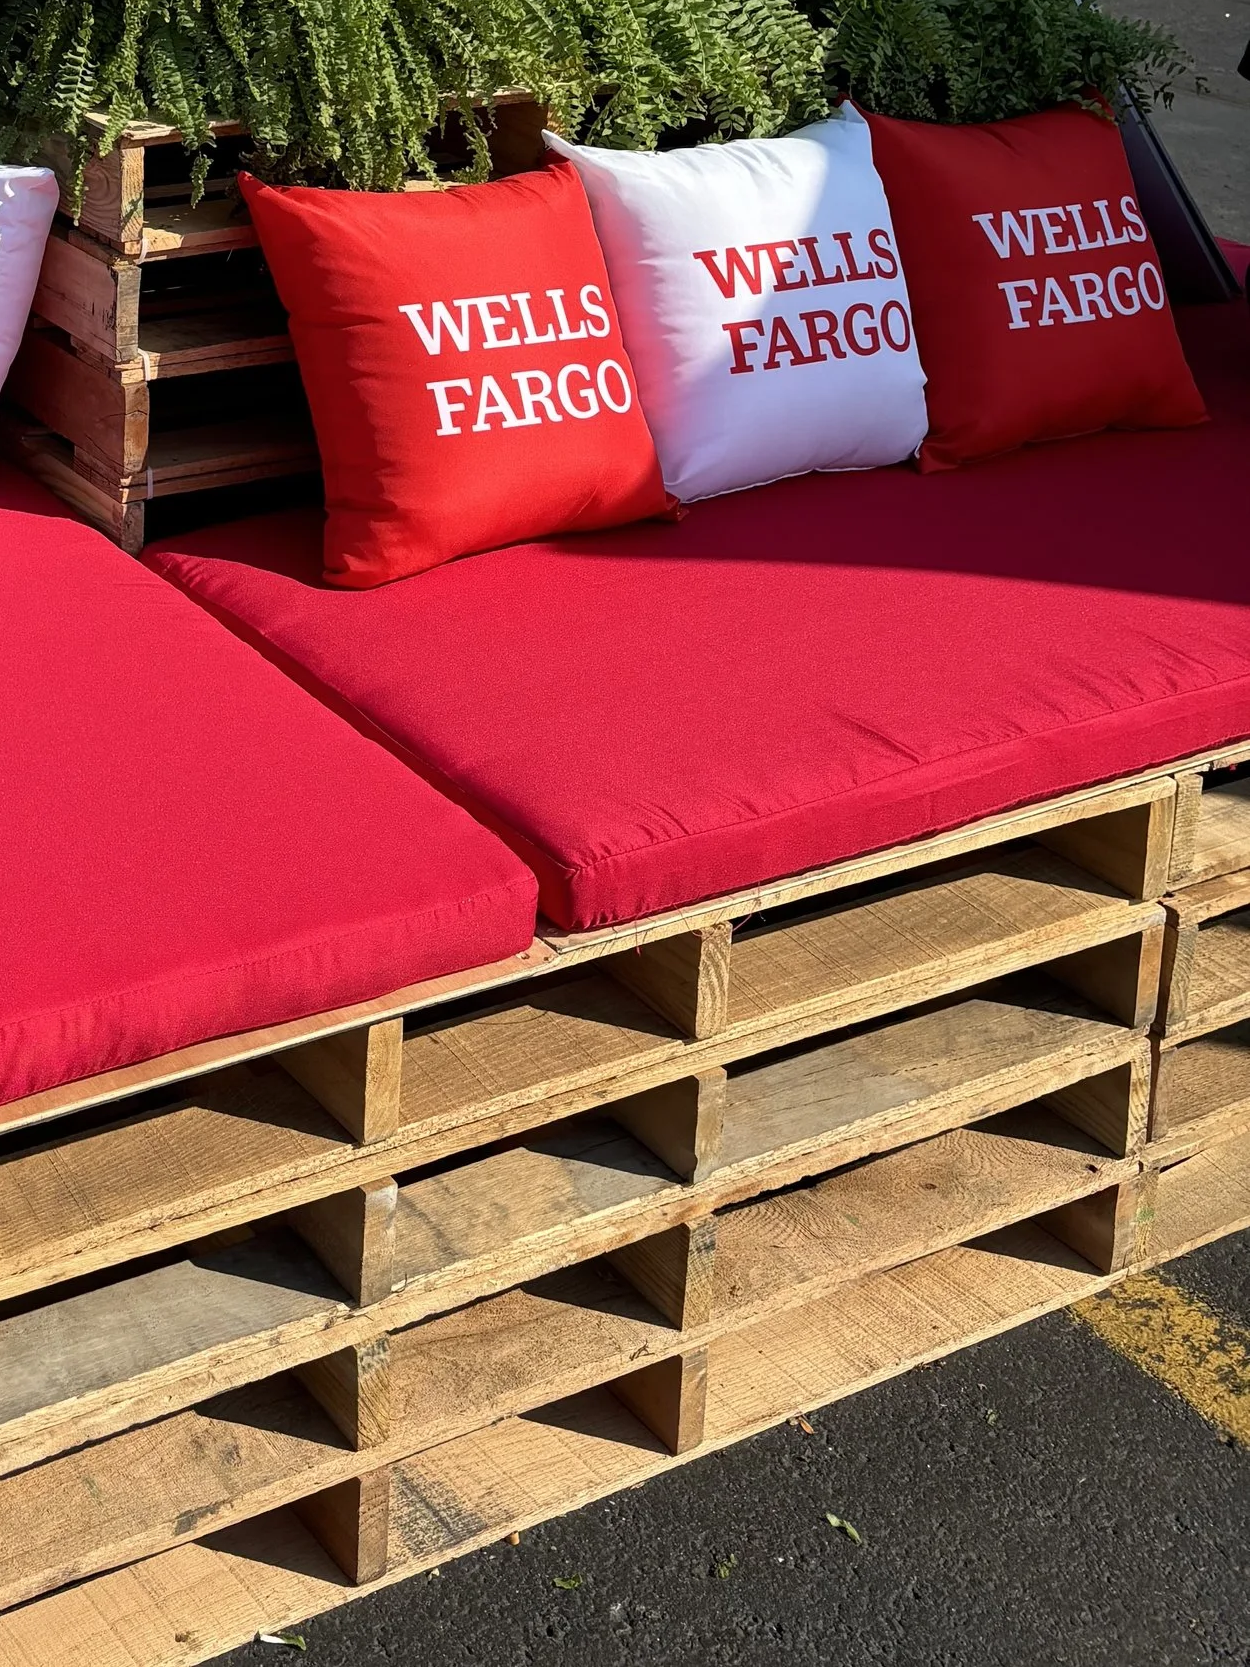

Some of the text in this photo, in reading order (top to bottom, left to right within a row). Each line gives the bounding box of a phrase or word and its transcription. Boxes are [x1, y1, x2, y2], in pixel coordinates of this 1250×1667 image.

[972, 195, 1148, 259] WELLS
[693, 228, 899, 299] WELLS
[997, 261, 1166, 330] FARGO
[398, 284, 611, 356] WELLS
[722, 300, 911, 375] FARGO
[426, 359, 633, 437] FARGO
